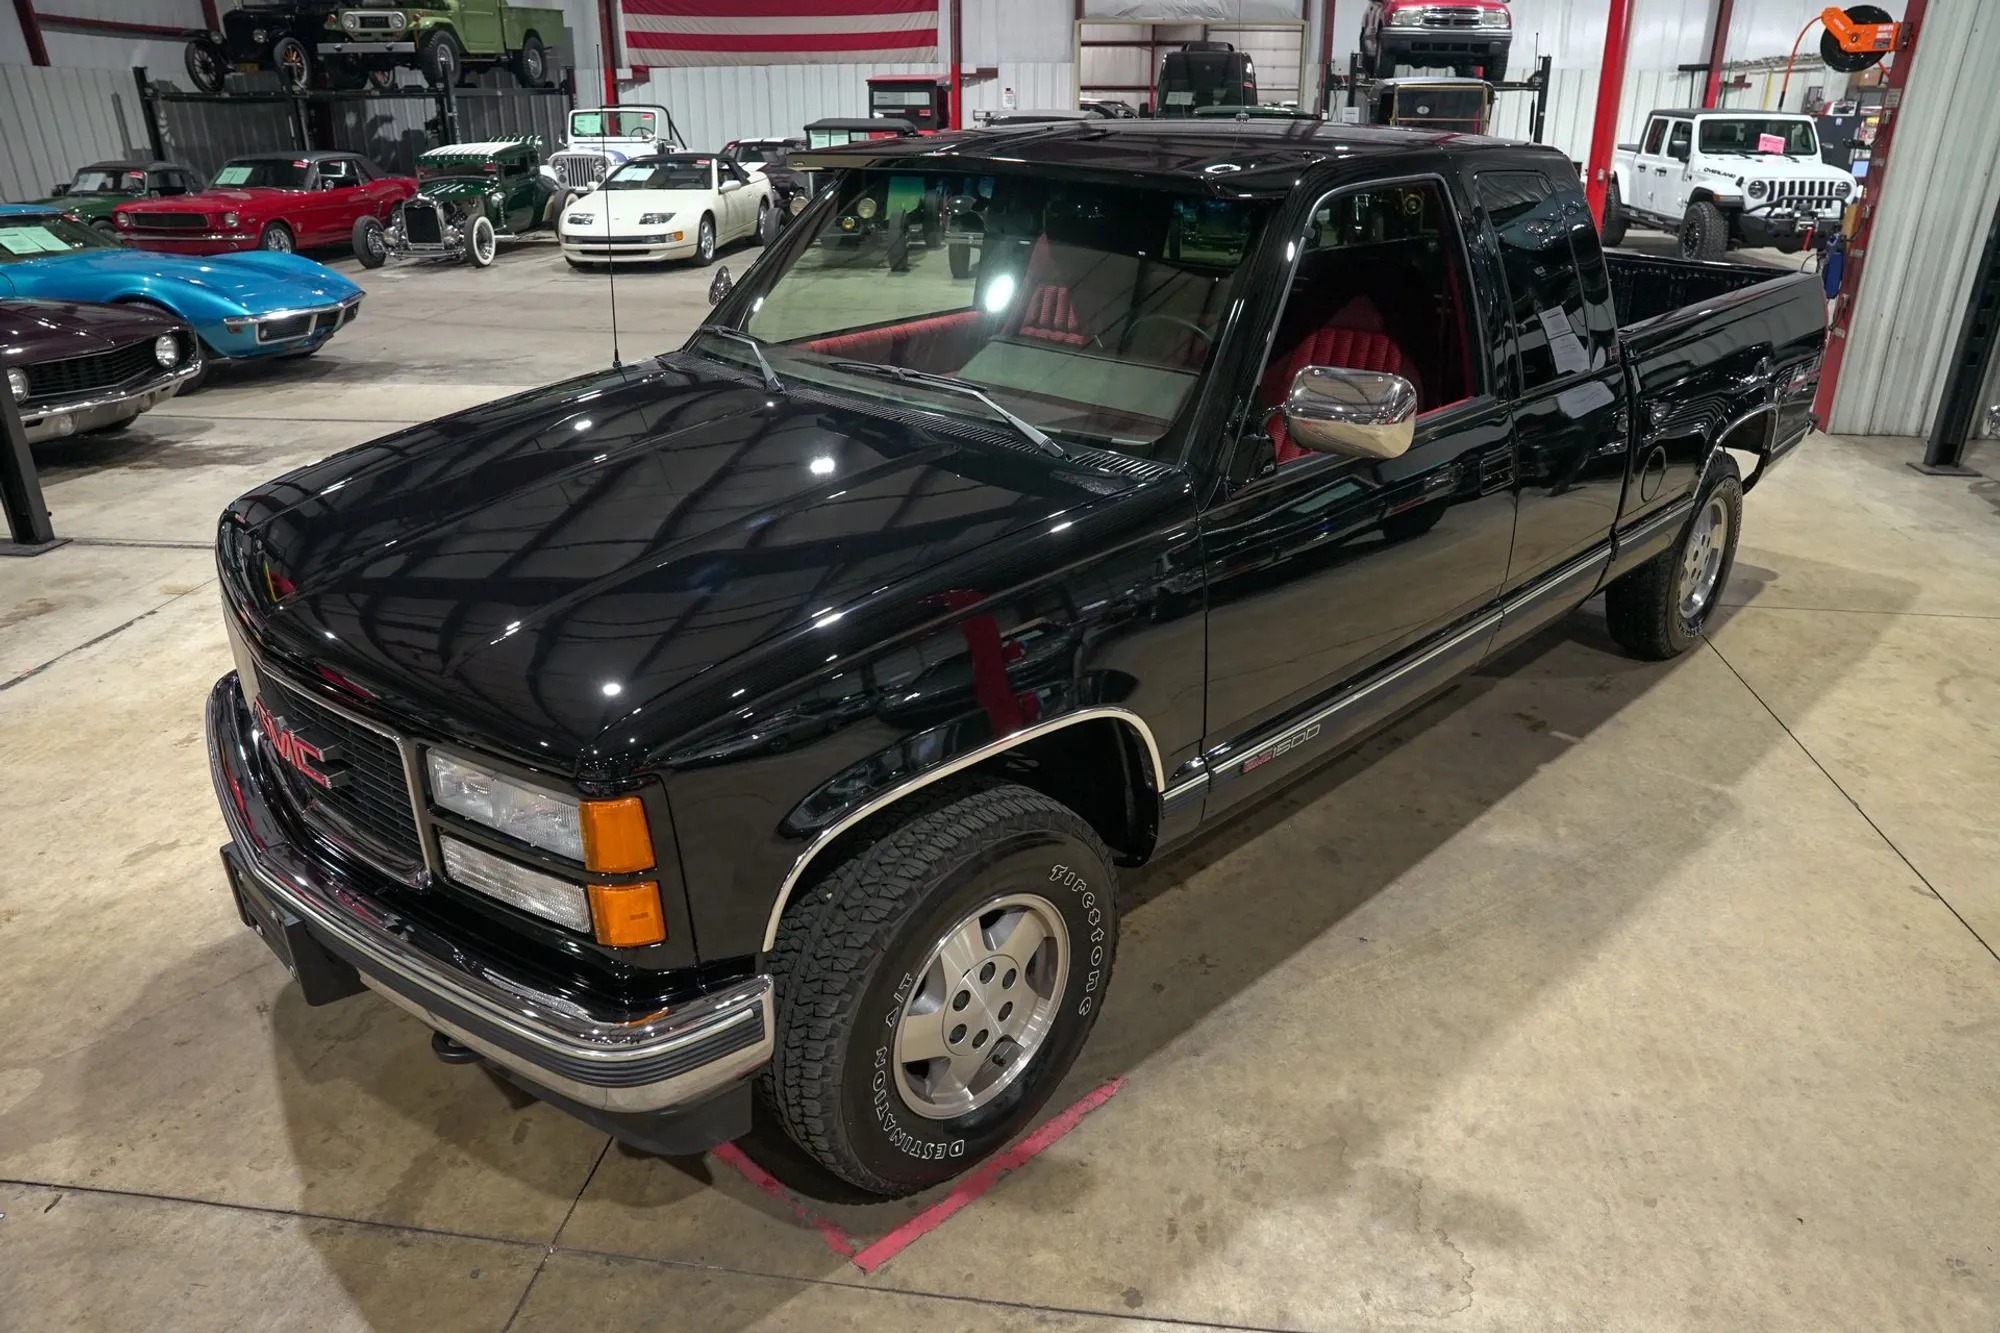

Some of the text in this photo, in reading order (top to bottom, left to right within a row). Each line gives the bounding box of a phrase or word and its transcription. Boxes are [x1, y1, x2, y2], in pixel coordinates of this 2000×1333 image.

[1703, 167, 1736, 179] OVERLAND
[1272, 723, 1321, 759] 1500
[871, 1046, 965, 1160] DESTINATION
